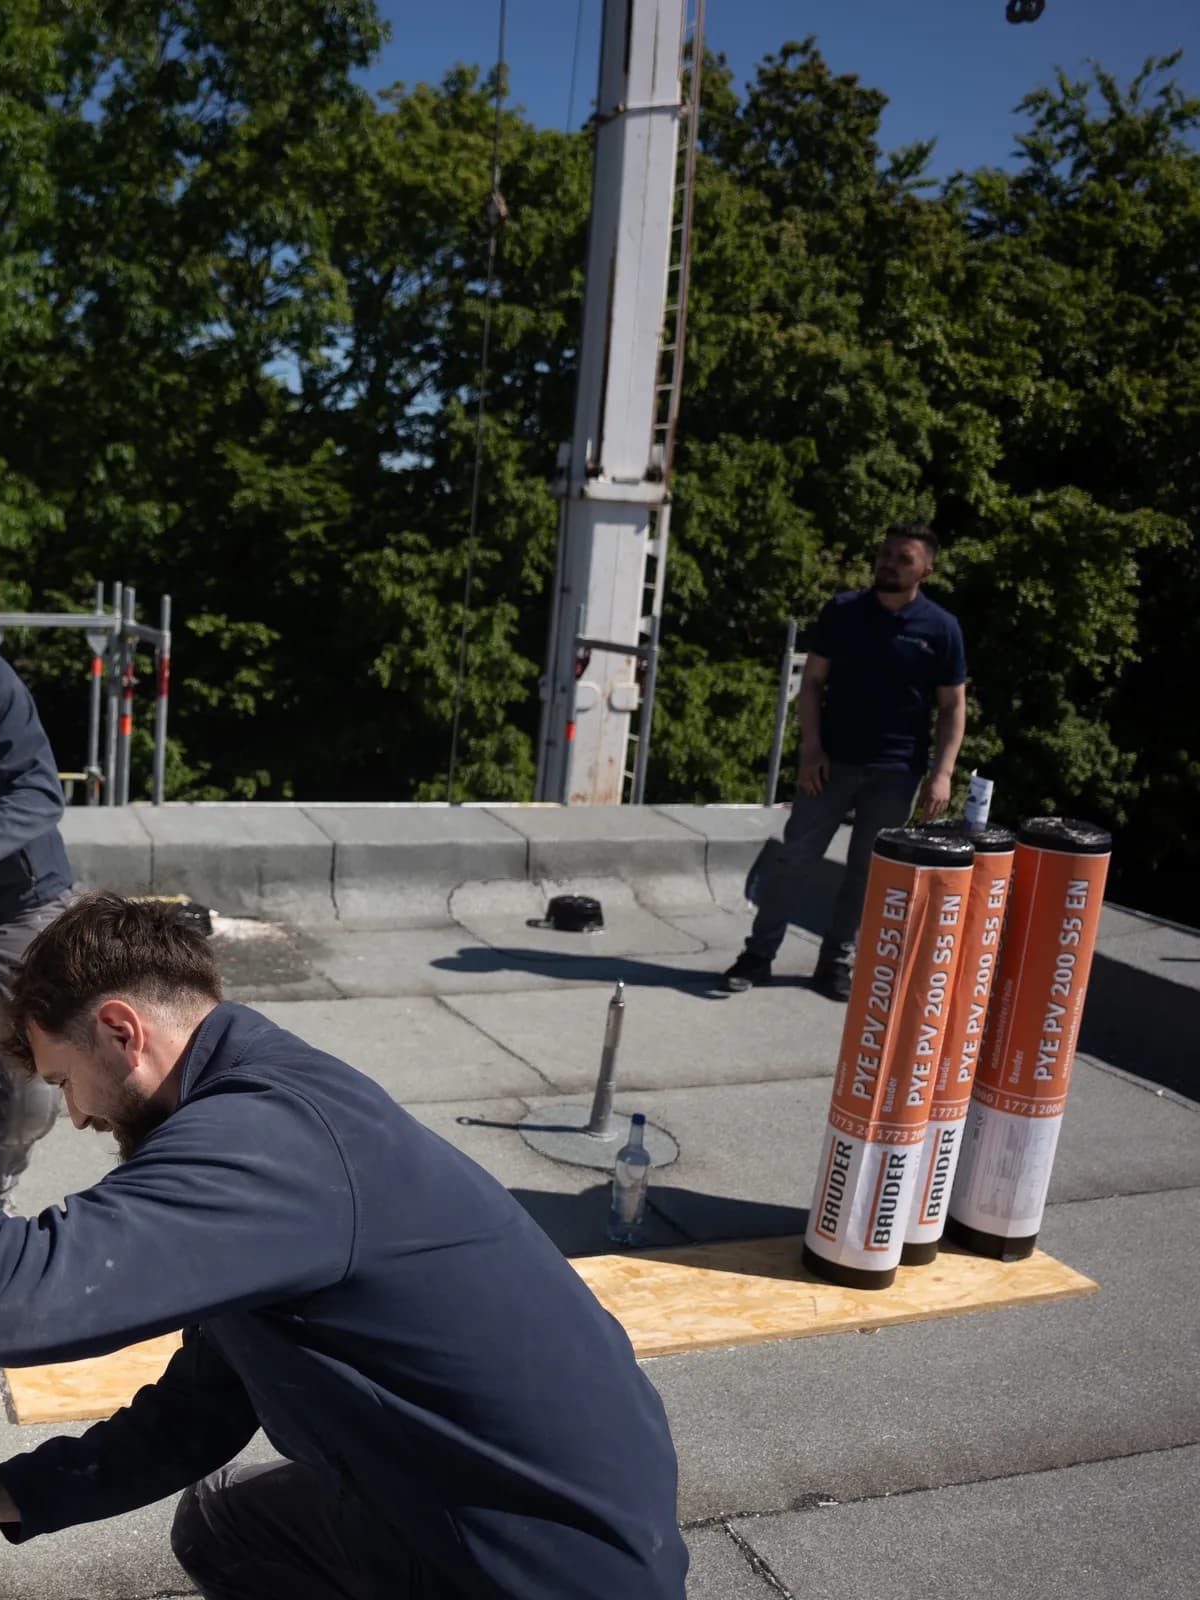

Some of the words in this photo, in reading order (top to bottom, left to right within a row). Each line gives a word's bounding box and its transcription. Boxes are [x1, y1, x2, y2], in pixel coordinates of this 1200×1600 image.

[883, 888, 908, 921] EN
[939, 895, 962, 926] EN
[987, 879, 1006, 909] EN
[1064, 880, 1089, 909] EN
[877, 928, 901, 960] S5
[982, 917, 999, 946] S5
[1059, 918, 1082, 947] S5
[933, 934, 955, 965] S5
[868, 965, 895, 1013] 200
[974, 953, 993, 997] 200
[1052, 953, 1076, 997] 200
[924, 972, 948, 1018] 200
[860, 1014, 885, 1049] PV
[966, 1003, 985, 1034] PV
[1043, 1002, 1066, 1033] PV
[916, 1024, 938, 1056] PV
[851, 1053, 880, 1100] PYE
[957, 1039, 978, 1083] PYE
[1033, 1039, 1060, 1081] PYE
[882, 1077, 897, 1113] Bauder
[906, 1061, 932, 1106] PYE
[821, 1140, 853, 1234] BAUDER
[927, 1128, 956, 1217] BAUDER
[873, 1153, 907, 1244] BAUDER
